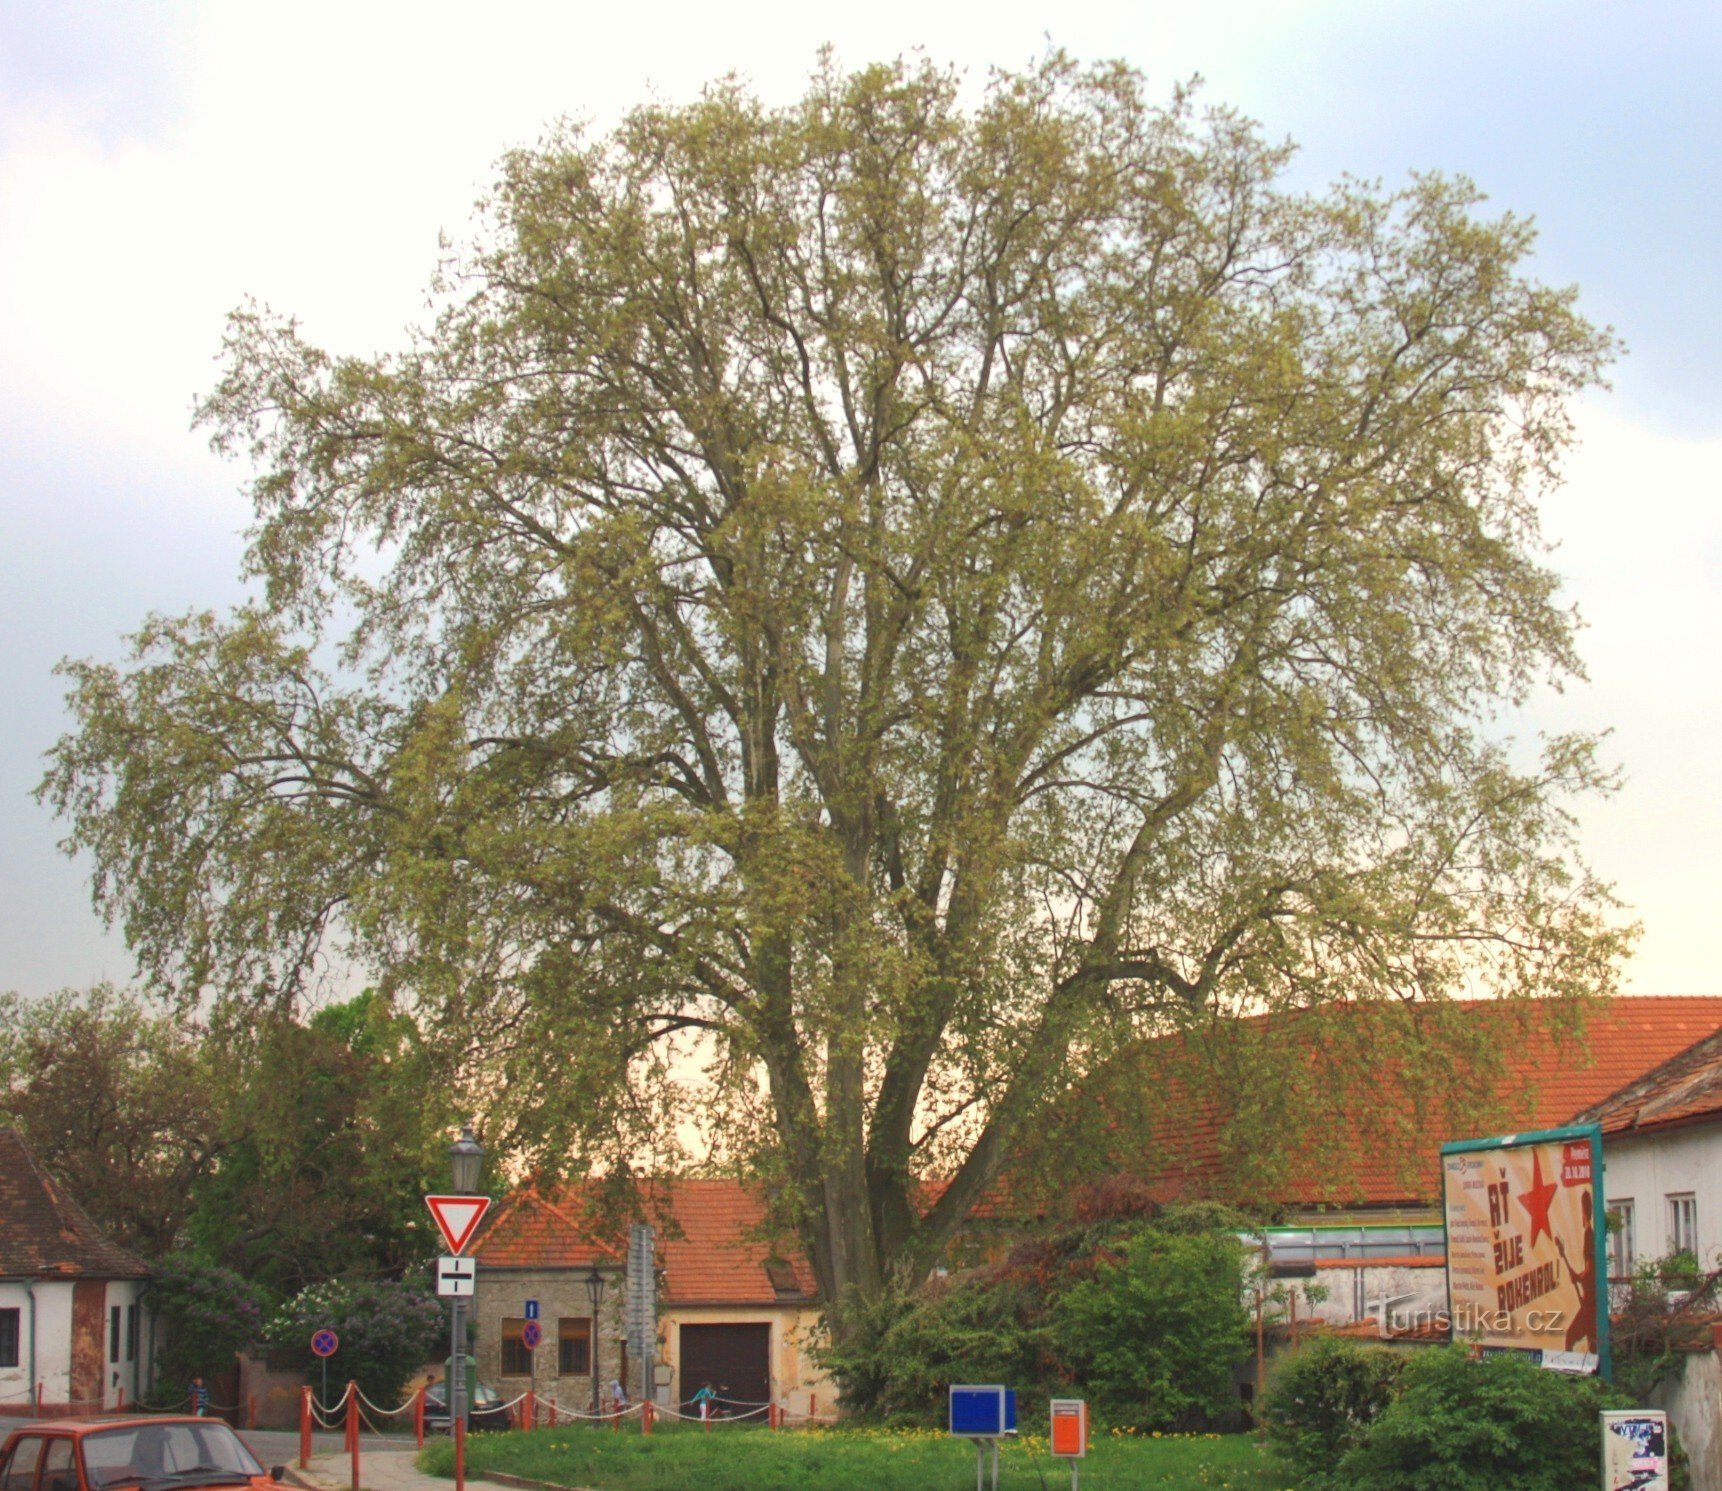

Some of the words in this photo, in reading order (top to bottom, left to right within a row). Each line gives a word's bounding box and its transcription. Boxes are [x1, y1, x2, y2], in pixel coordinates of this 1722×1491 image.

[1487, 1167, 1509, 1228] AŤ
[1493, 1229, 1523, 1276] ŽIJE
[1497, 1258, 1560, 1314] ROKENROL!
